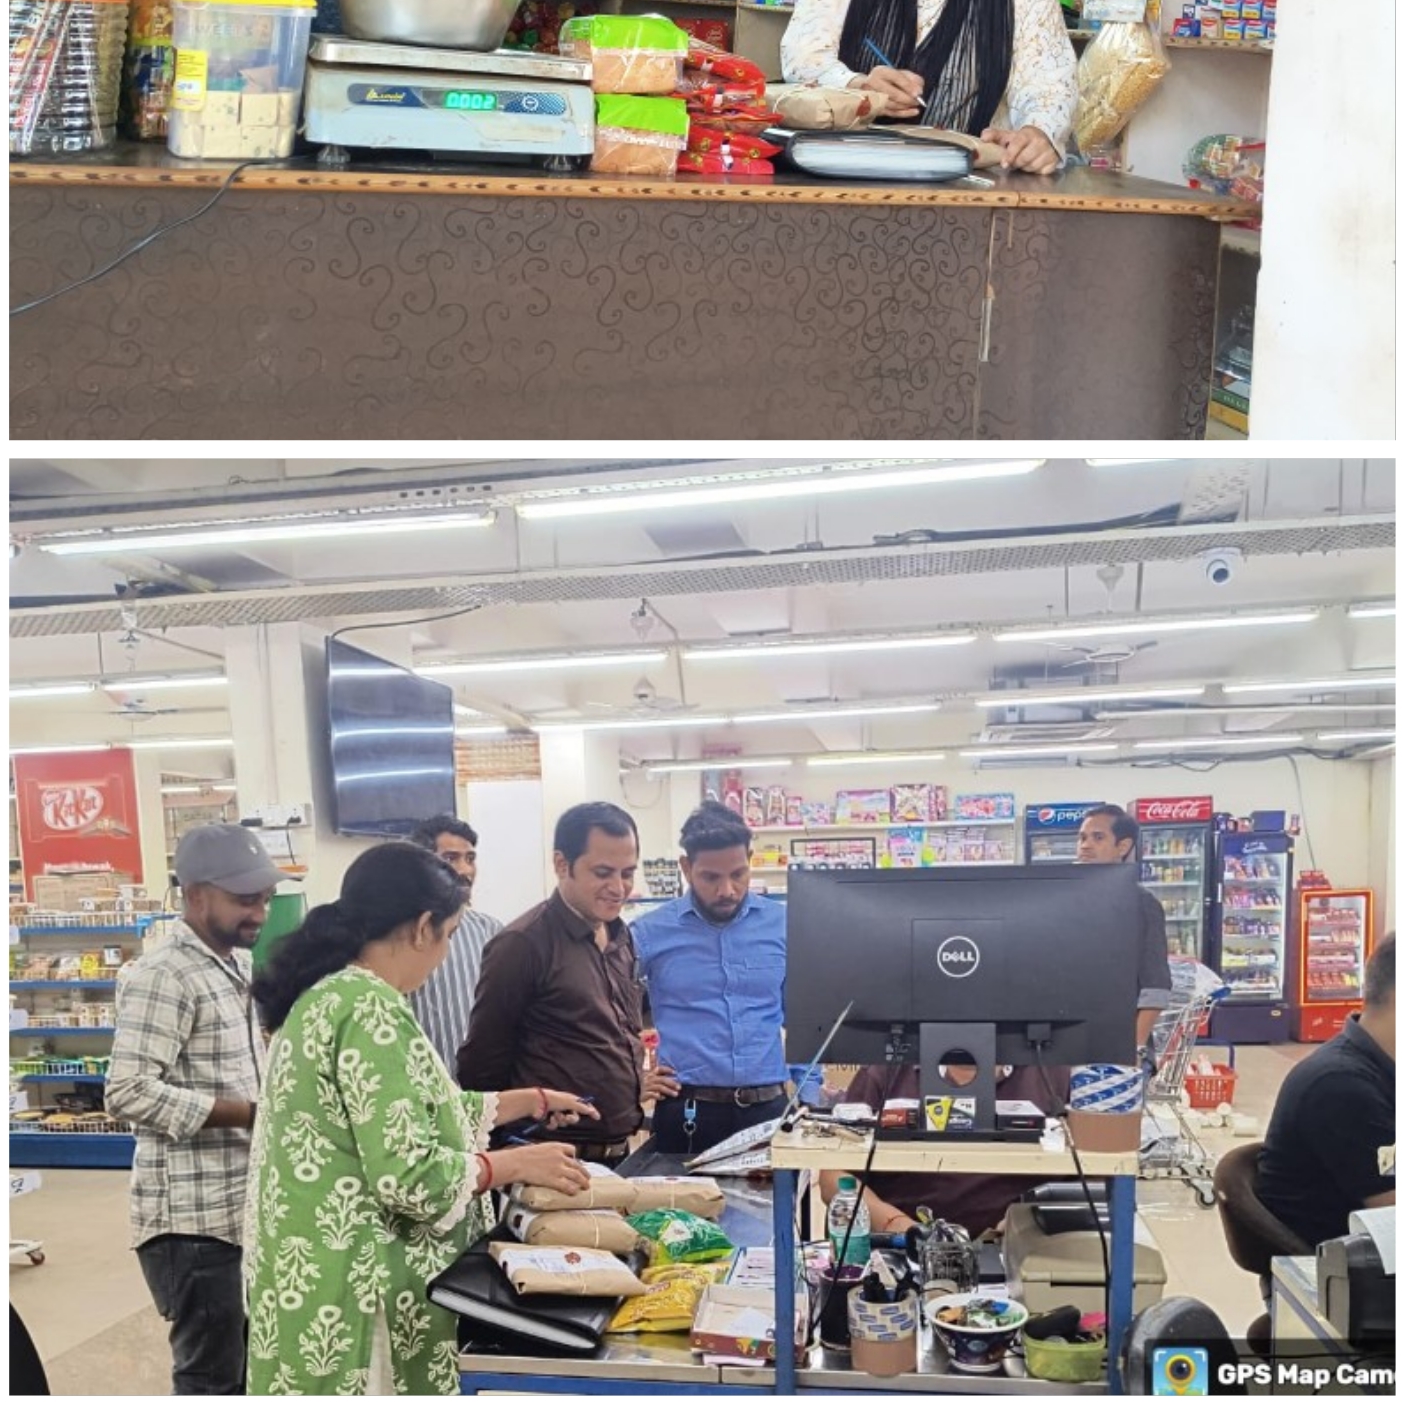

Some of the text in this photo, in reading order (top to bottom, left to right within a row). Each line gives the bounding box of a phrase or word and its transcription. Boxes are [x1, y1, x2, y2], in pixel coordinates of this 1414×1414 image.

[49, 788, 98, 827] KitKat
[1057, 809, 1087, 823] peps
[1146, 799, 1201, 820] Coca-Cola
[942, 951, 975, 962] DELL
